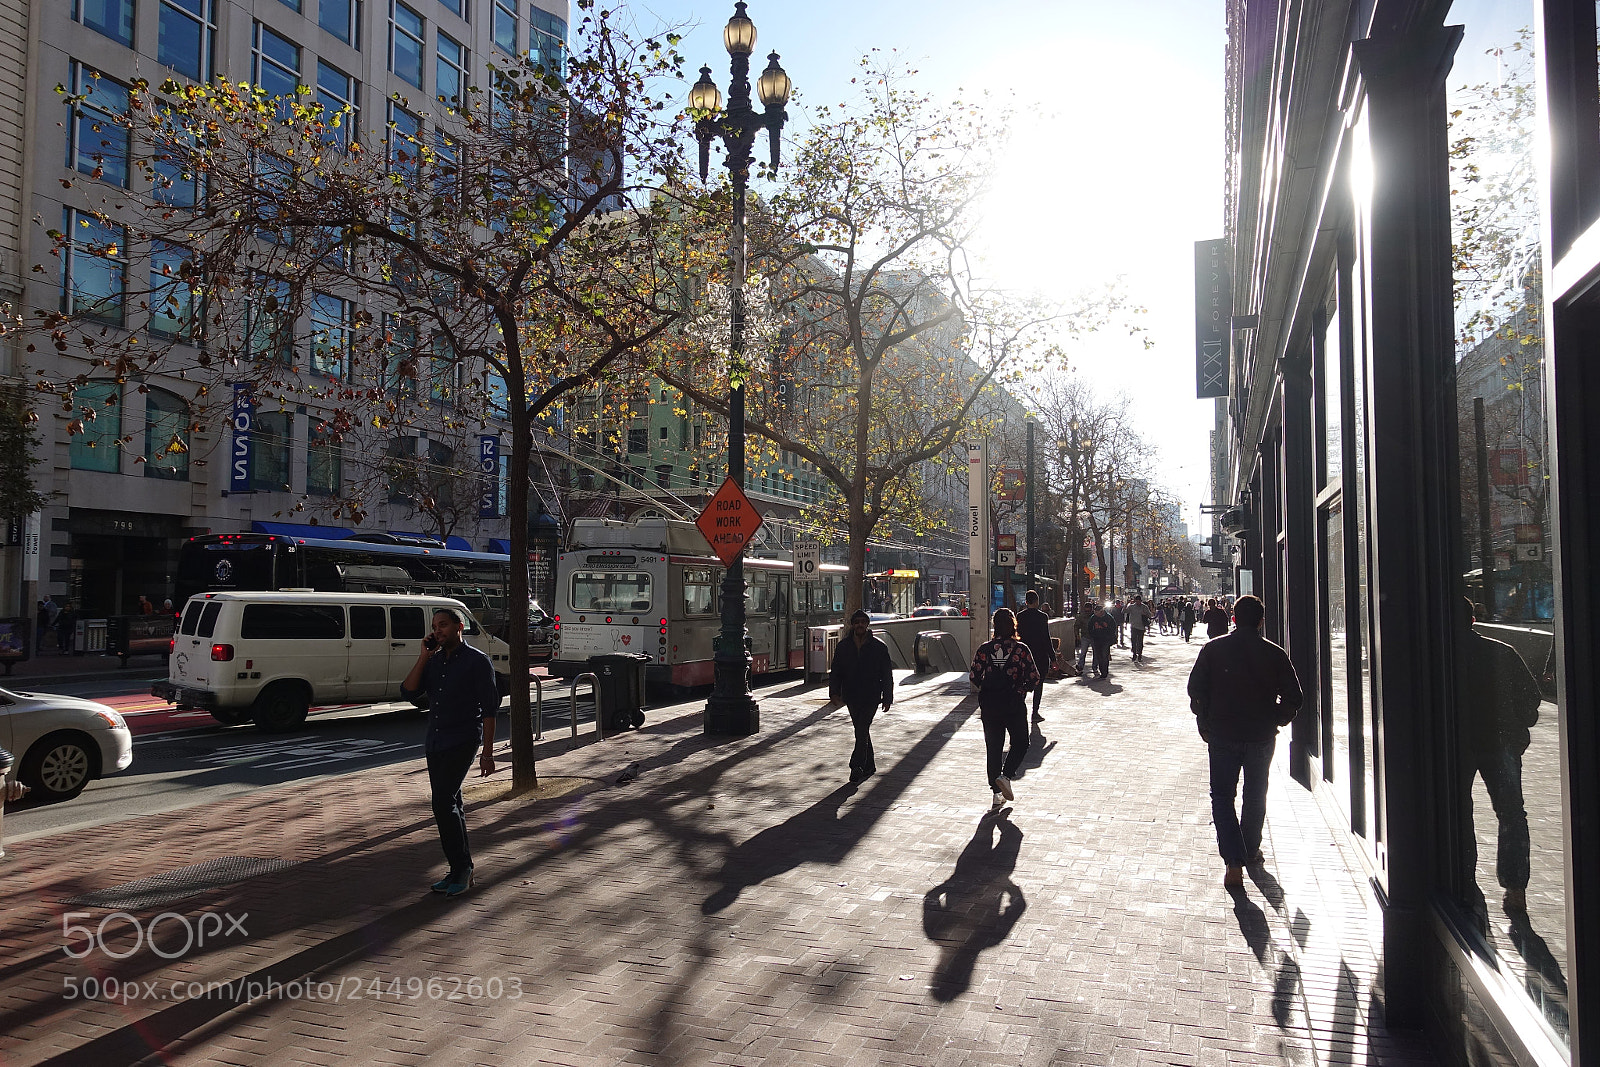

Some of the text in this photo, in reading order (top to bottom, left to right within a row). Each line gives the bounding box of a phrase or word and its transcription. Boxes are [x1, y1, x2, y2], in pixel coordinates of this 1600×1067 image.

[1211, 246, 1220, 332] FOREVER
[1203, 338, 1223, 391] XXI
[234, 388, 250, 480] ROSS
[481, 440, 495, 509] ROSS
[716, 500, 742, 511] ROAD
[113, 521, 133, 530] 799
[716, 516, 742, 528] WORK
[970, 506, 979, 537] Powell
[713, 532, 744, 544] AHEAD
[795, 543, 818, 551] SPEED
[797, 551, 816, 559] LIMIT
[798, 560, 815, 574] 10
